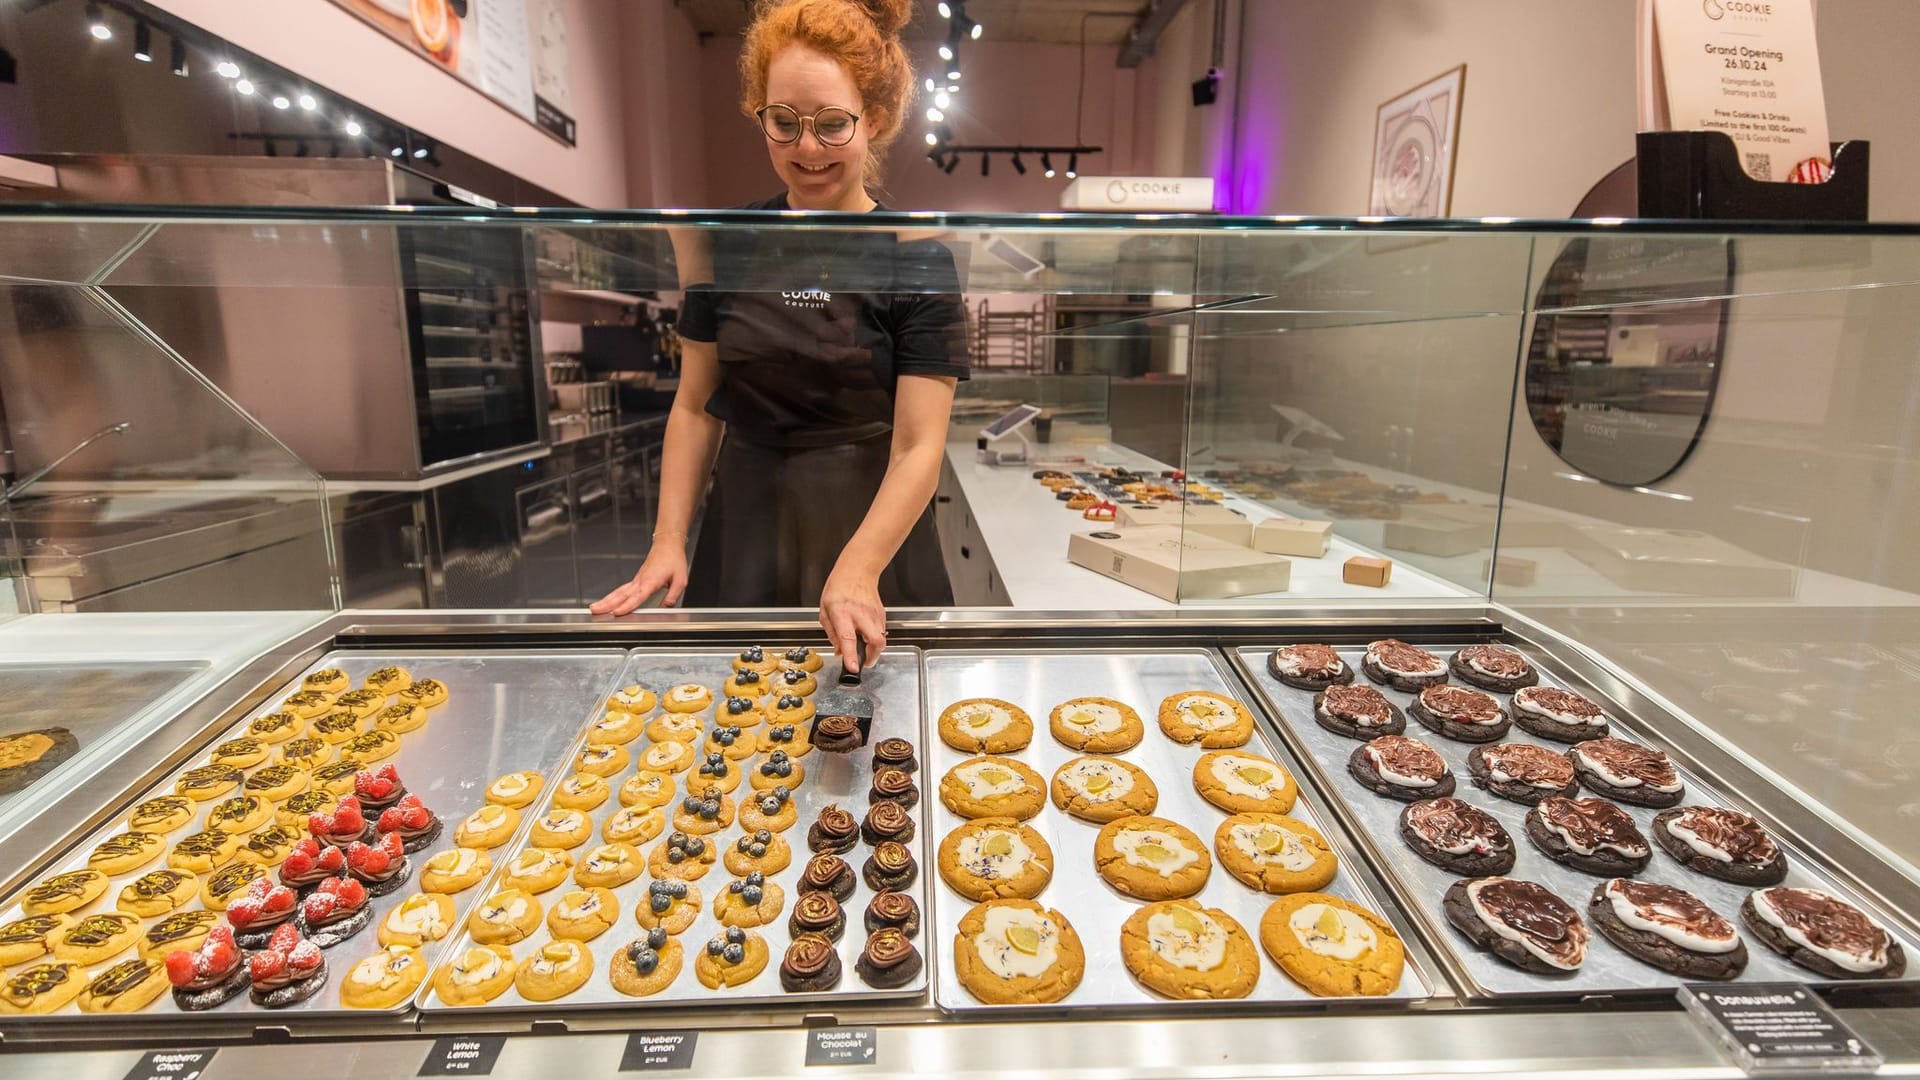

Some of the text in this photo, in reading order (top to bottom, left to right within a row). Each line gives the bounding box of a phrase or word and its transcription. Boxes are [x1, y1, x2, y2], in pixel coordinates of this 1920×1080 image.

[1726, 1, 1772, 15] COOKIE
[1704, 43, 1784, 62] Grand Opening
[1725, 58, 1767, 71] 26.10.24
[1714, 108, 1791, 122] Free Cookies & Drinks
[1730, 121, 1738, 129] to
[1739, 122, 1751, 130] the
[1753, 122, 1767, 131] first
[1753, 133, 1772, 143] Good
[1132, 182, 1182, 195] COOKIE
[640, 1035, 684, 1045] Blueberry
[817, 1031, 868, 1041] Mousse au
[452, 1042, 481, 1051] White
[643, 1044, 676, 1053] Lemon
[821, 1039, 863, 1049] Chocolat
[152, 1054, 202, 1063] Raspberry
[446, 1050, 479, 1059] Lemon
[156, 1063, 184, 1071] Choc
